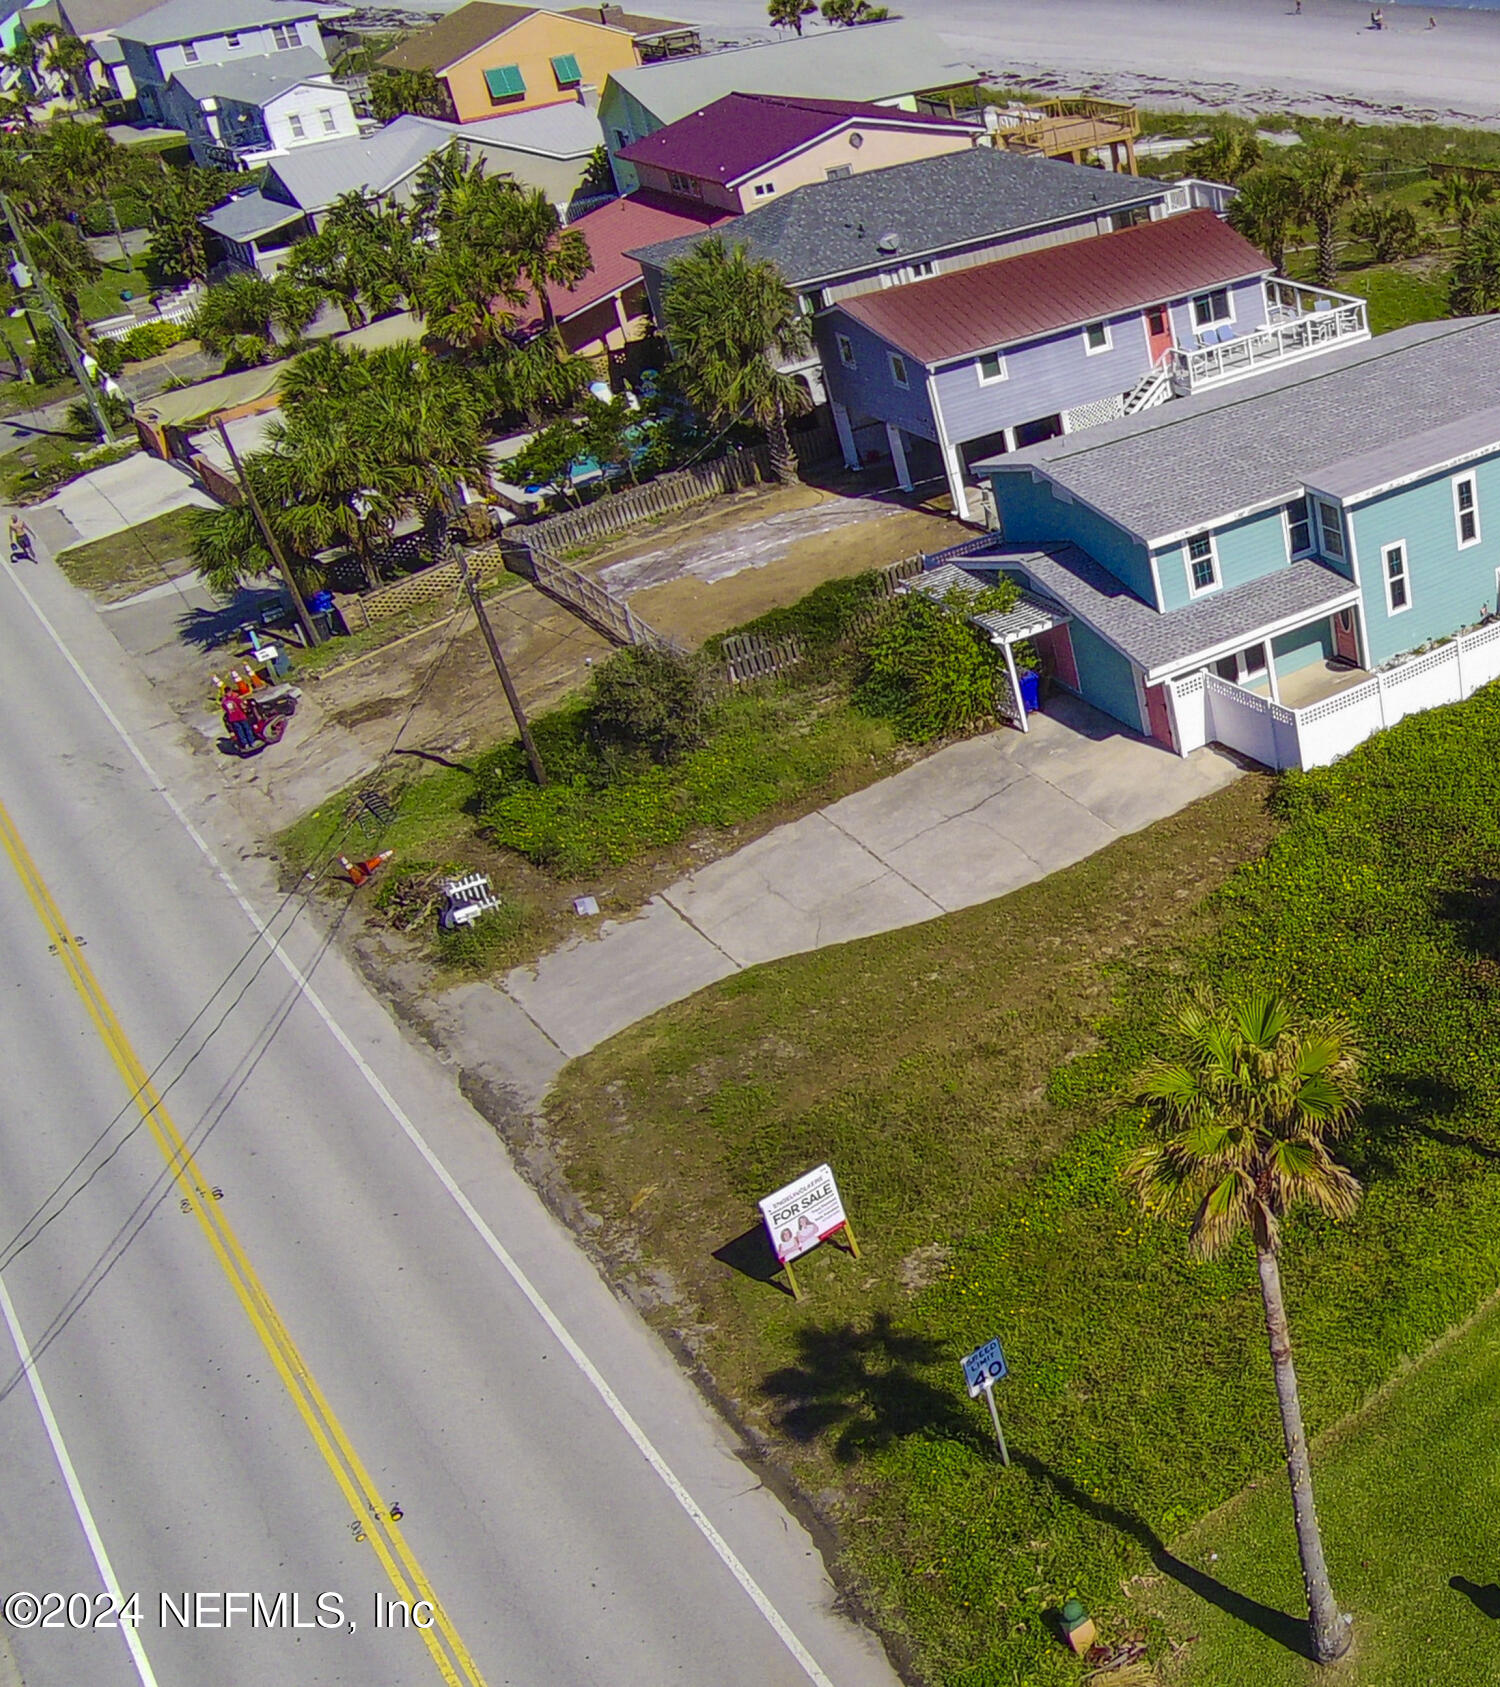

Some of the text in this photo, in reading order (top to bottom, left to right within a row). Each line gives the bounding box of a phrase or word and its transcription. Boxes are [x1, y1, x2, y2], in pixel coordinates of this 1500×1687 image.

[773, 1203, 800, 1225] FOR
[801, 1183, 833, 1209] SALE
[966, 1342, 997, 1367] SPEED
[971, 1352, 995, 1372] LIMIT
[973, 1360, 1002, 1387] 40
